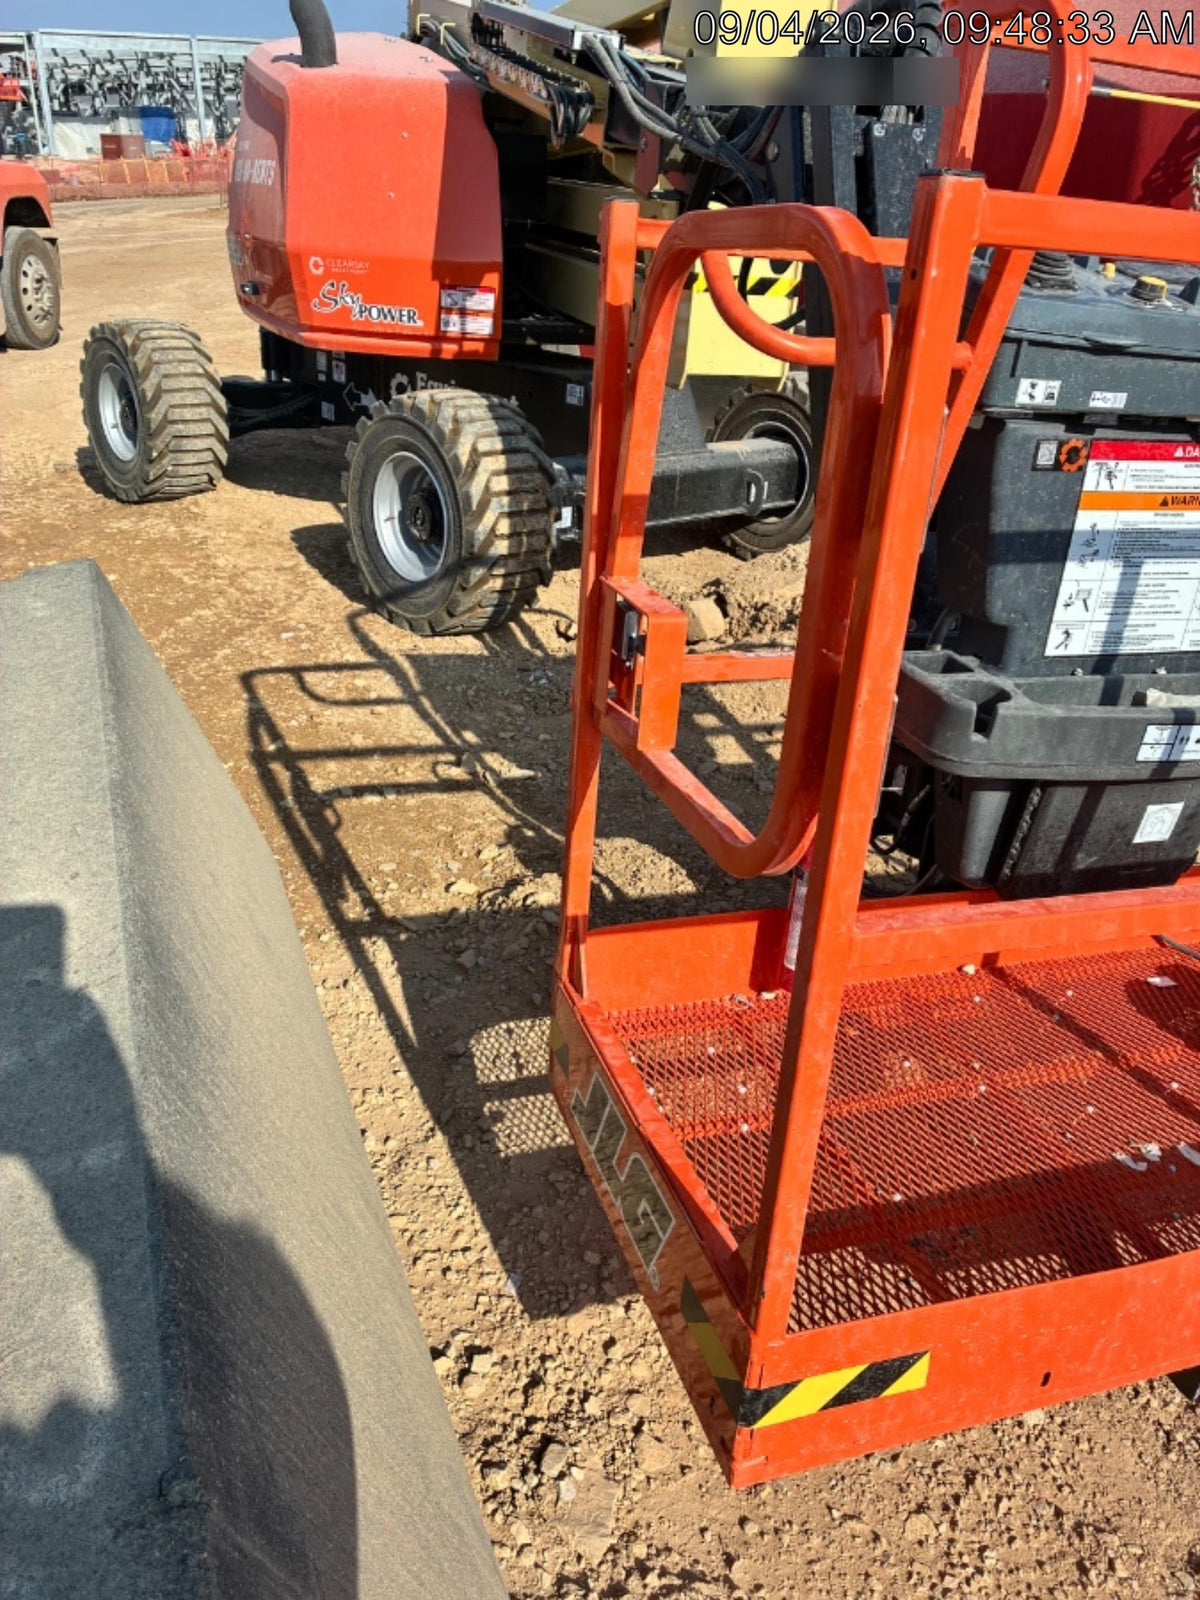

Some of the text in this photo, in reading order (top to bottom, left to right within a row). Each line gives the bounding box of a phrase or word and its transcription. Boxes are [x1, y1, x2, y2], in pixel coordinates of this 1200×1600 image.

[311, 279, 419, 325] Sky POWER
[570, 1070, 676, 1280] JLG
